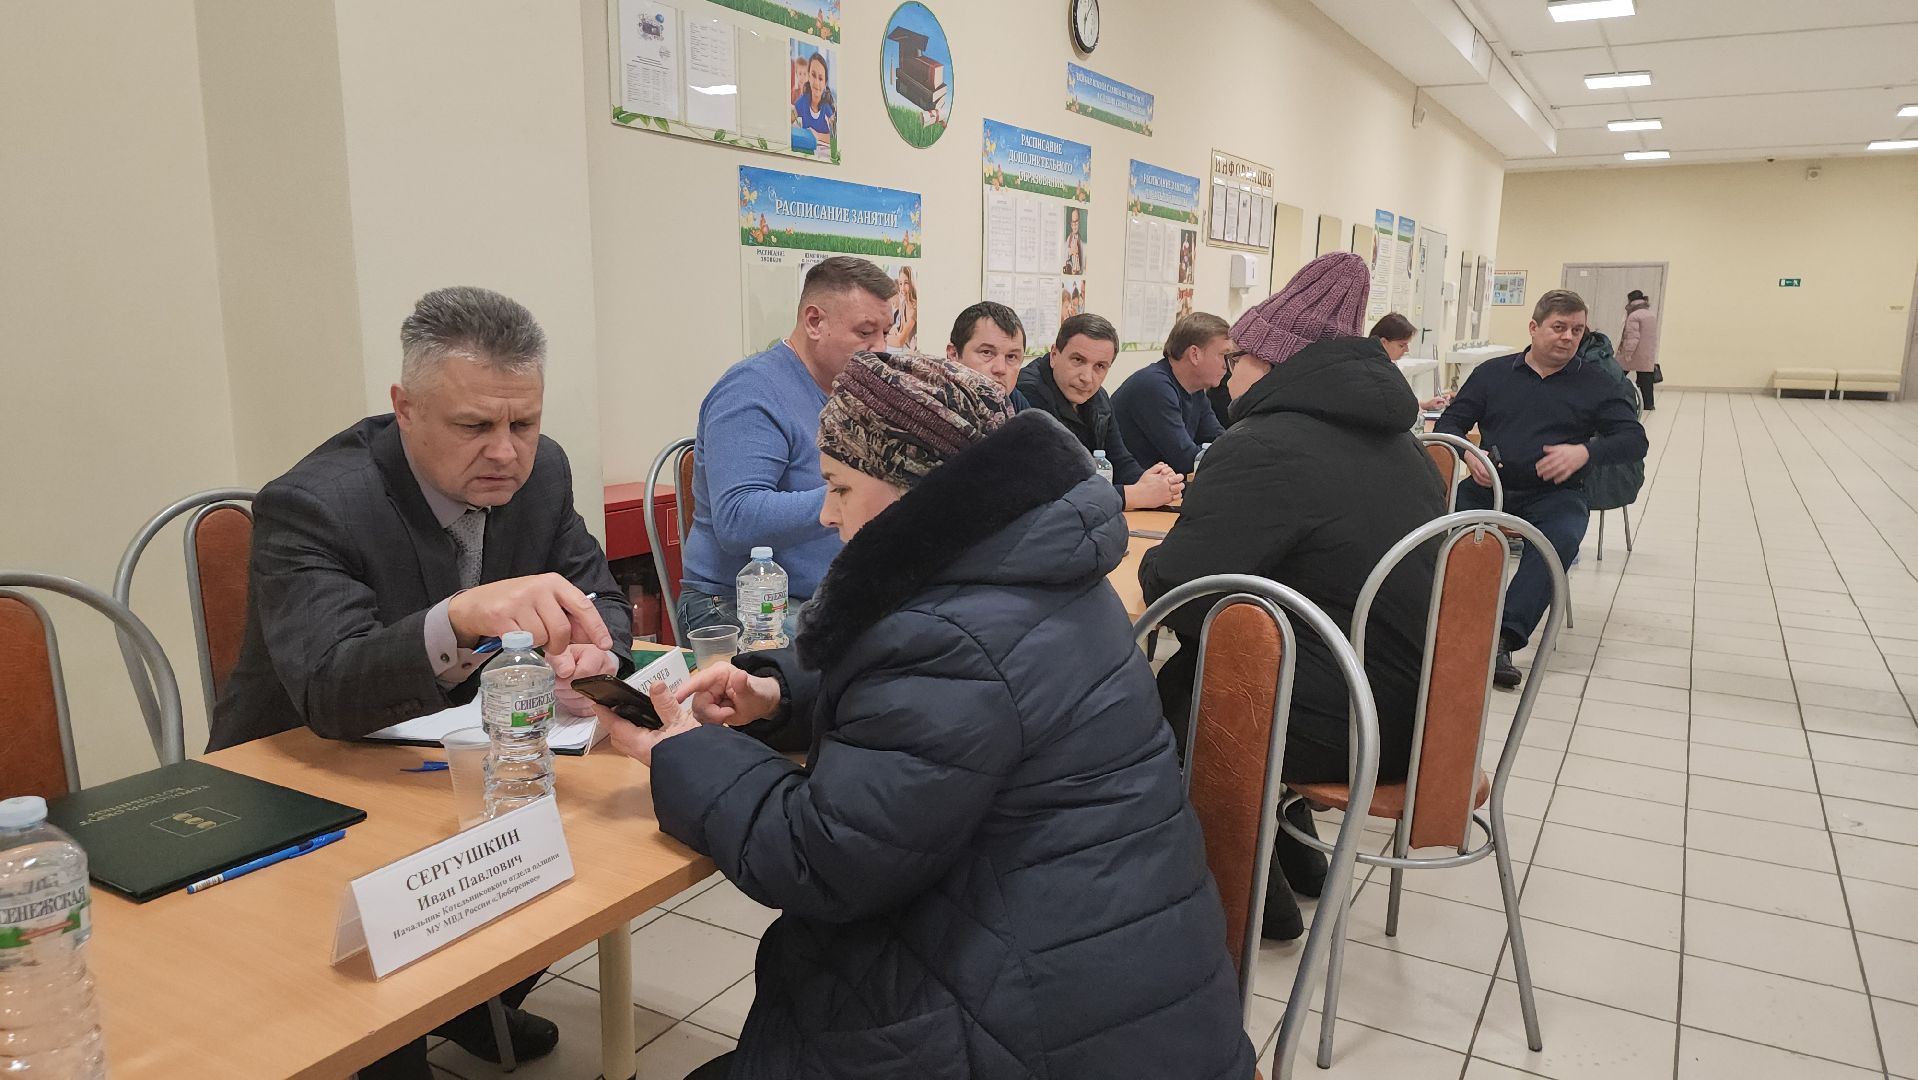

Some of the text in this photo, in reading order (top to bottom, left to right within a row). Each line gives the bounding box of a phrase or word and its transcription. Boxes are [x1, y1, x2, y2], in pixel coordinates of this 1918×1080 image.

[1021, 134, 1063, 155] РАСПИСАНИЕ
[1008, 149, 1073, 175] ДОПОЛНИТЕЛЬНОГО
[1019, 171, 1065, 189] ОБРАЗОВАНИЯ
[775, 200, 899, 228] РАСПИСАНИЕ ЗАНЯТИЙ
[405, 828, 521, 891] СЕРГУШКИН
[417, 854, 523, 911] Иван Павлович
[392, 911, 441, 940] Начальник
[508, 866, 531, 883] отдела
[425, 923, 442, 937] МУ
[443, 912, 464, 929] МВД
[464, 900, 491, 917] России
